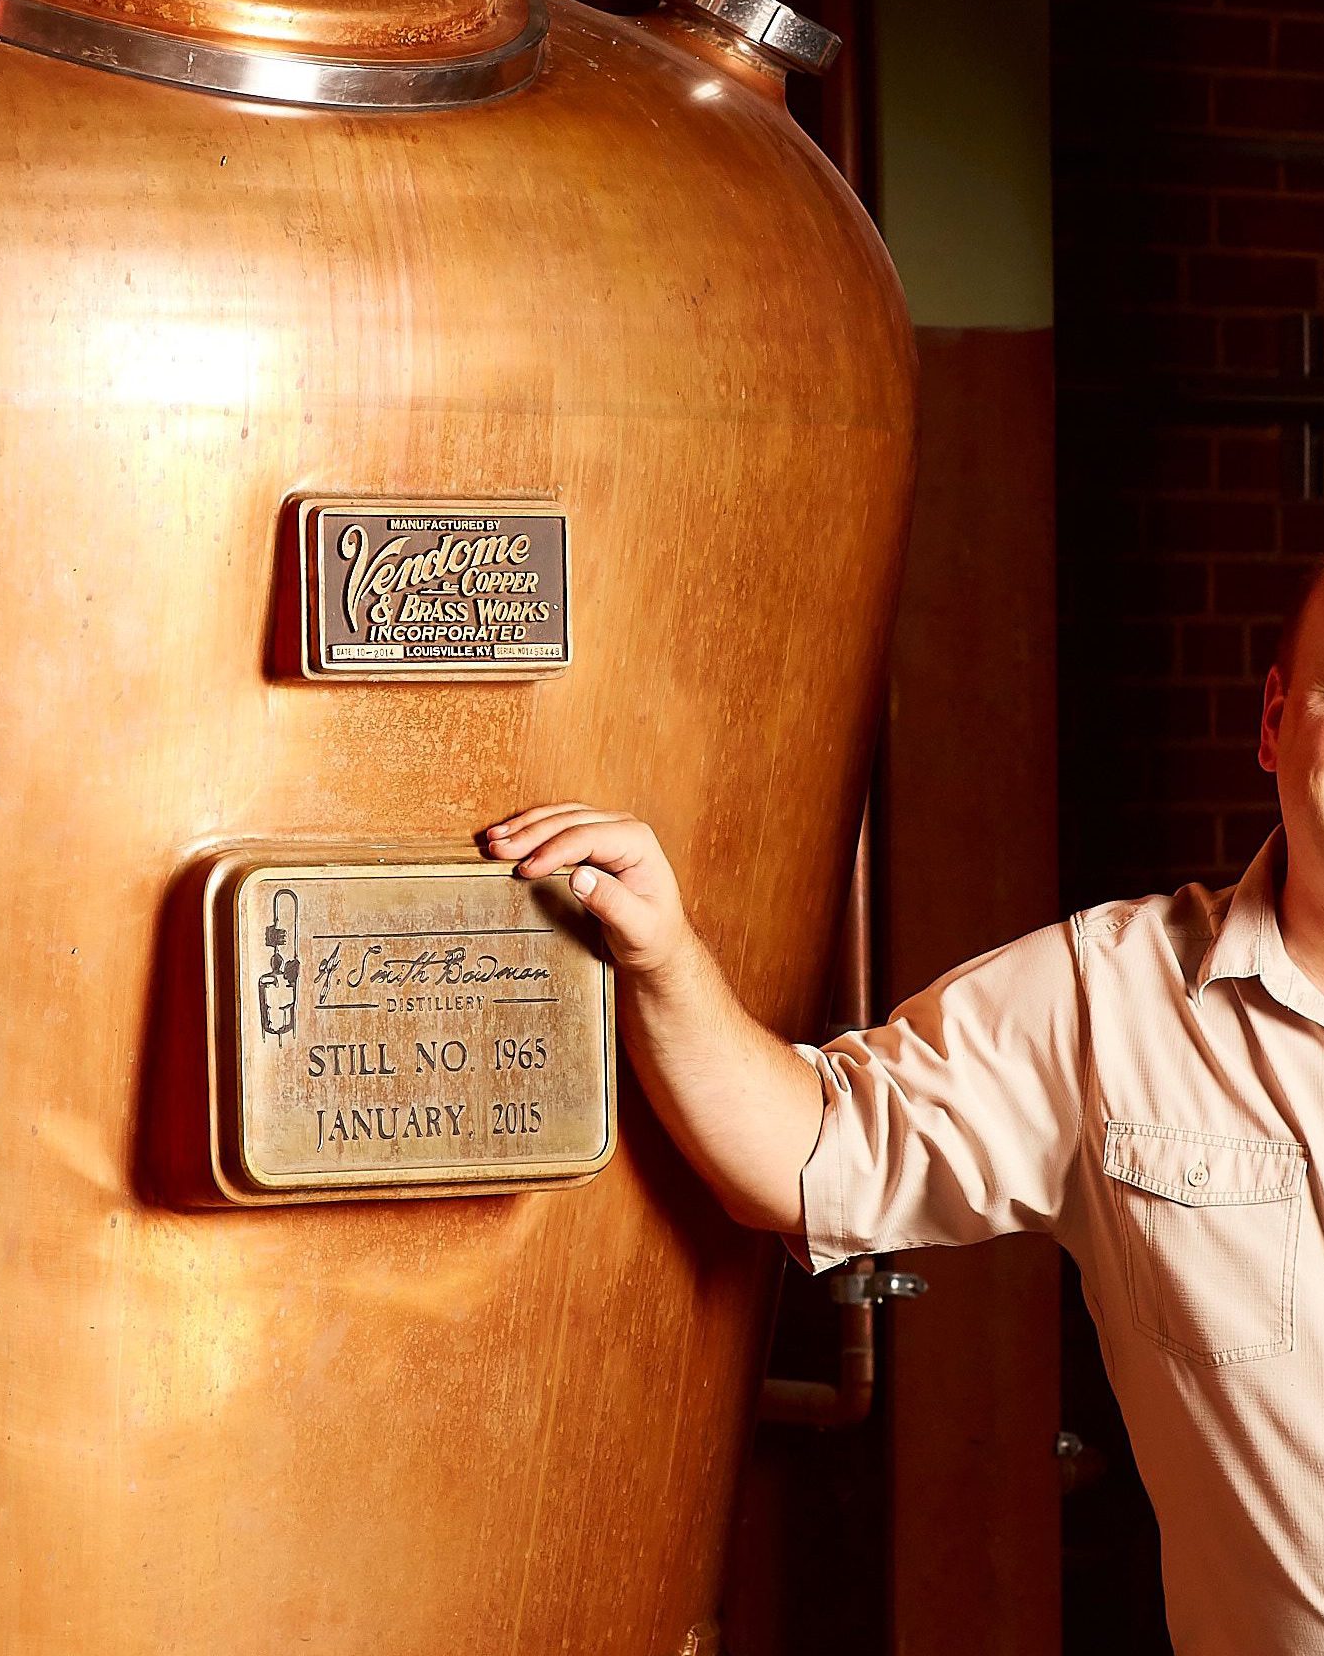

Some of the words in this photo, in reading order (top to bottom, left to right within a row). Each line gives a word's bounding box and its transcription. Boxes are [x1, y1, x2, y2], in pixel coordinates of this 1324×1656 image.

[390, 519, 484, 531] MANUFACTURED
[486, 520, 501, 531] BY
[341, 524, 532, 632] Vendome
[462, 567, 540, 597] COPPER
[370, 593, 394, 627] &
[399, 593, 469, 623] BRASS
[476, 598, 550, 623] WORKS
[369, 625, 527, 642] INCORPORATED
[336, 648, 351, 656] DATE
[497, 647, 516, 655] SERIAL
[347, 945, 432, 987] Smith
[435, 946, 550, 986] Bowman
[386, 995, 485, 1012] DISTILLERY
[308, 1043, 396, 1078] STILL
[415, 1040, 476, 1075] NO.
[494, 1038, 548, 1071] 1965
[316, 1104, 475, 1153] JANUARY,
[491, 1102, 543, 1136] 2015
